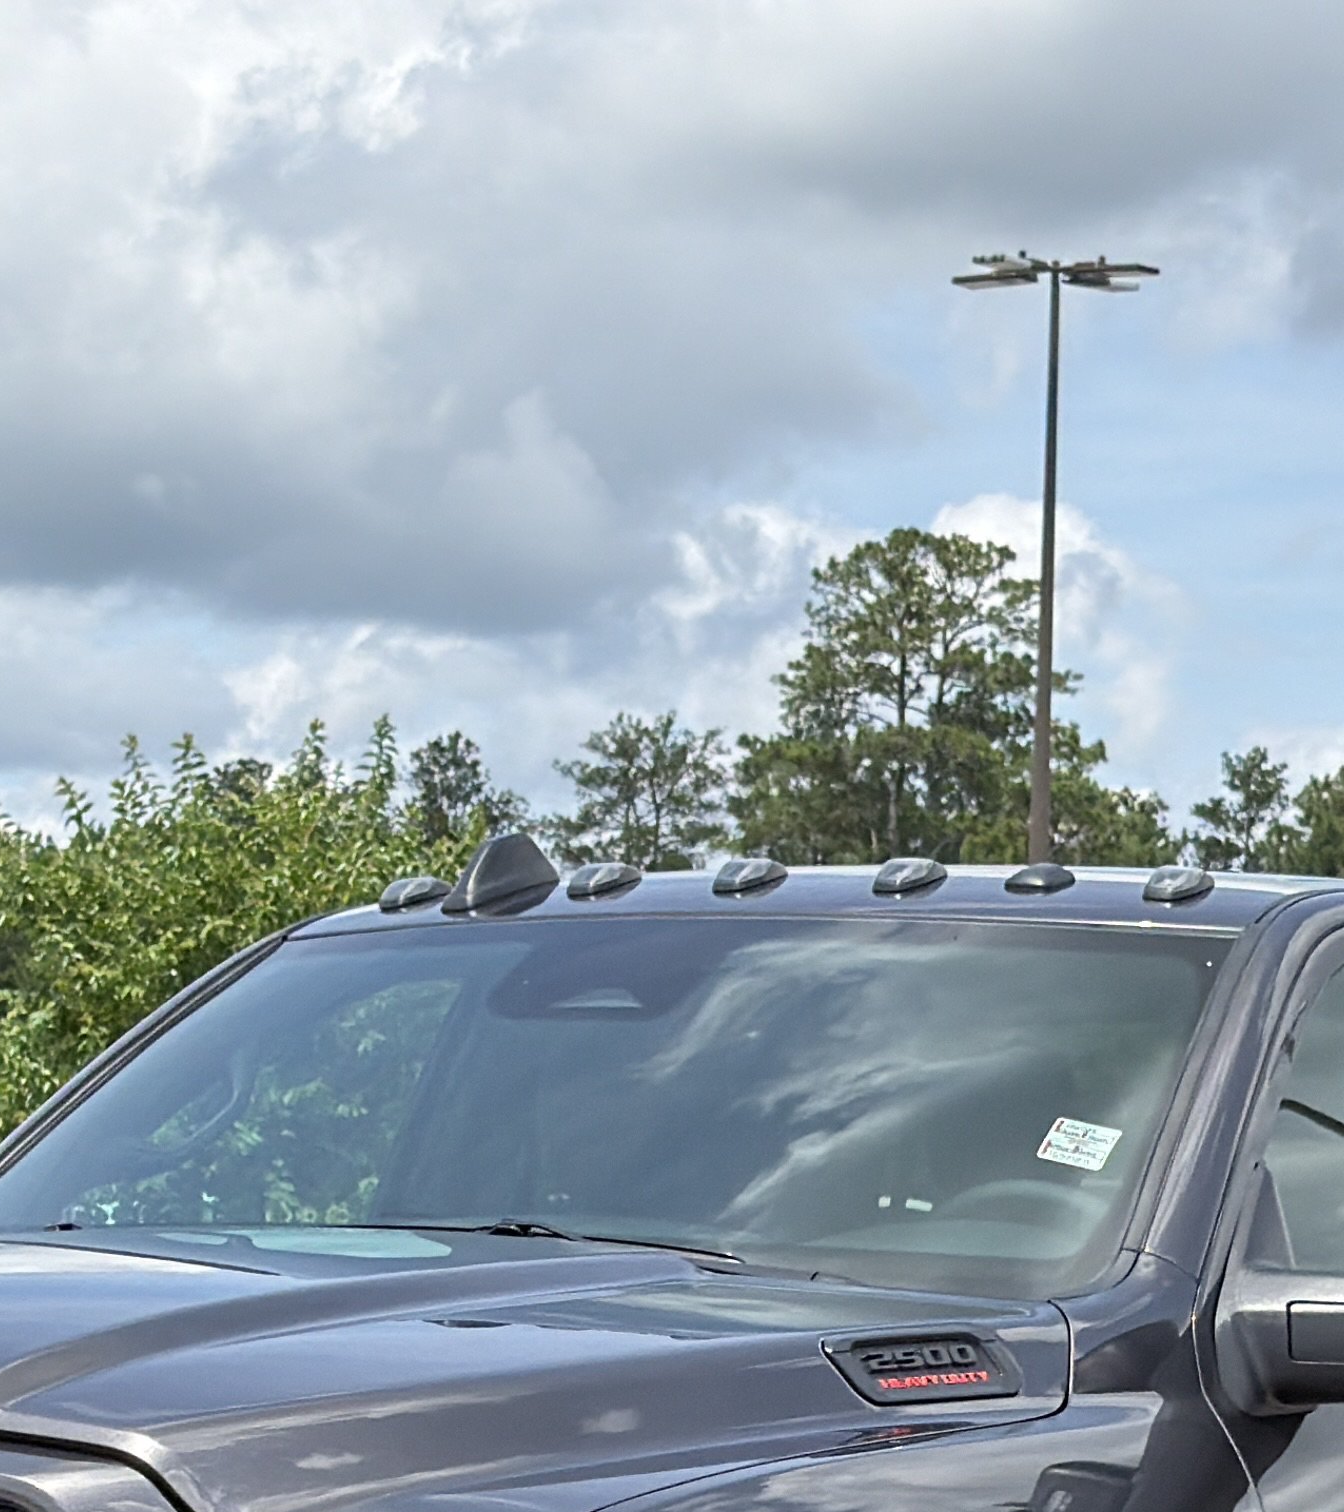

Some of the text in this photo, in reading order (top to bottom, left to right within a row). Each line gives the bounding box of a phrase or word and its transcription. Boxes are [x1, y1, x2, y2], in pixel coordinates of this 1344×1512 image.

[862, 1344, 977, 1374] 2500
[878, 1371, 988, 1389] HEAVY DUTY
